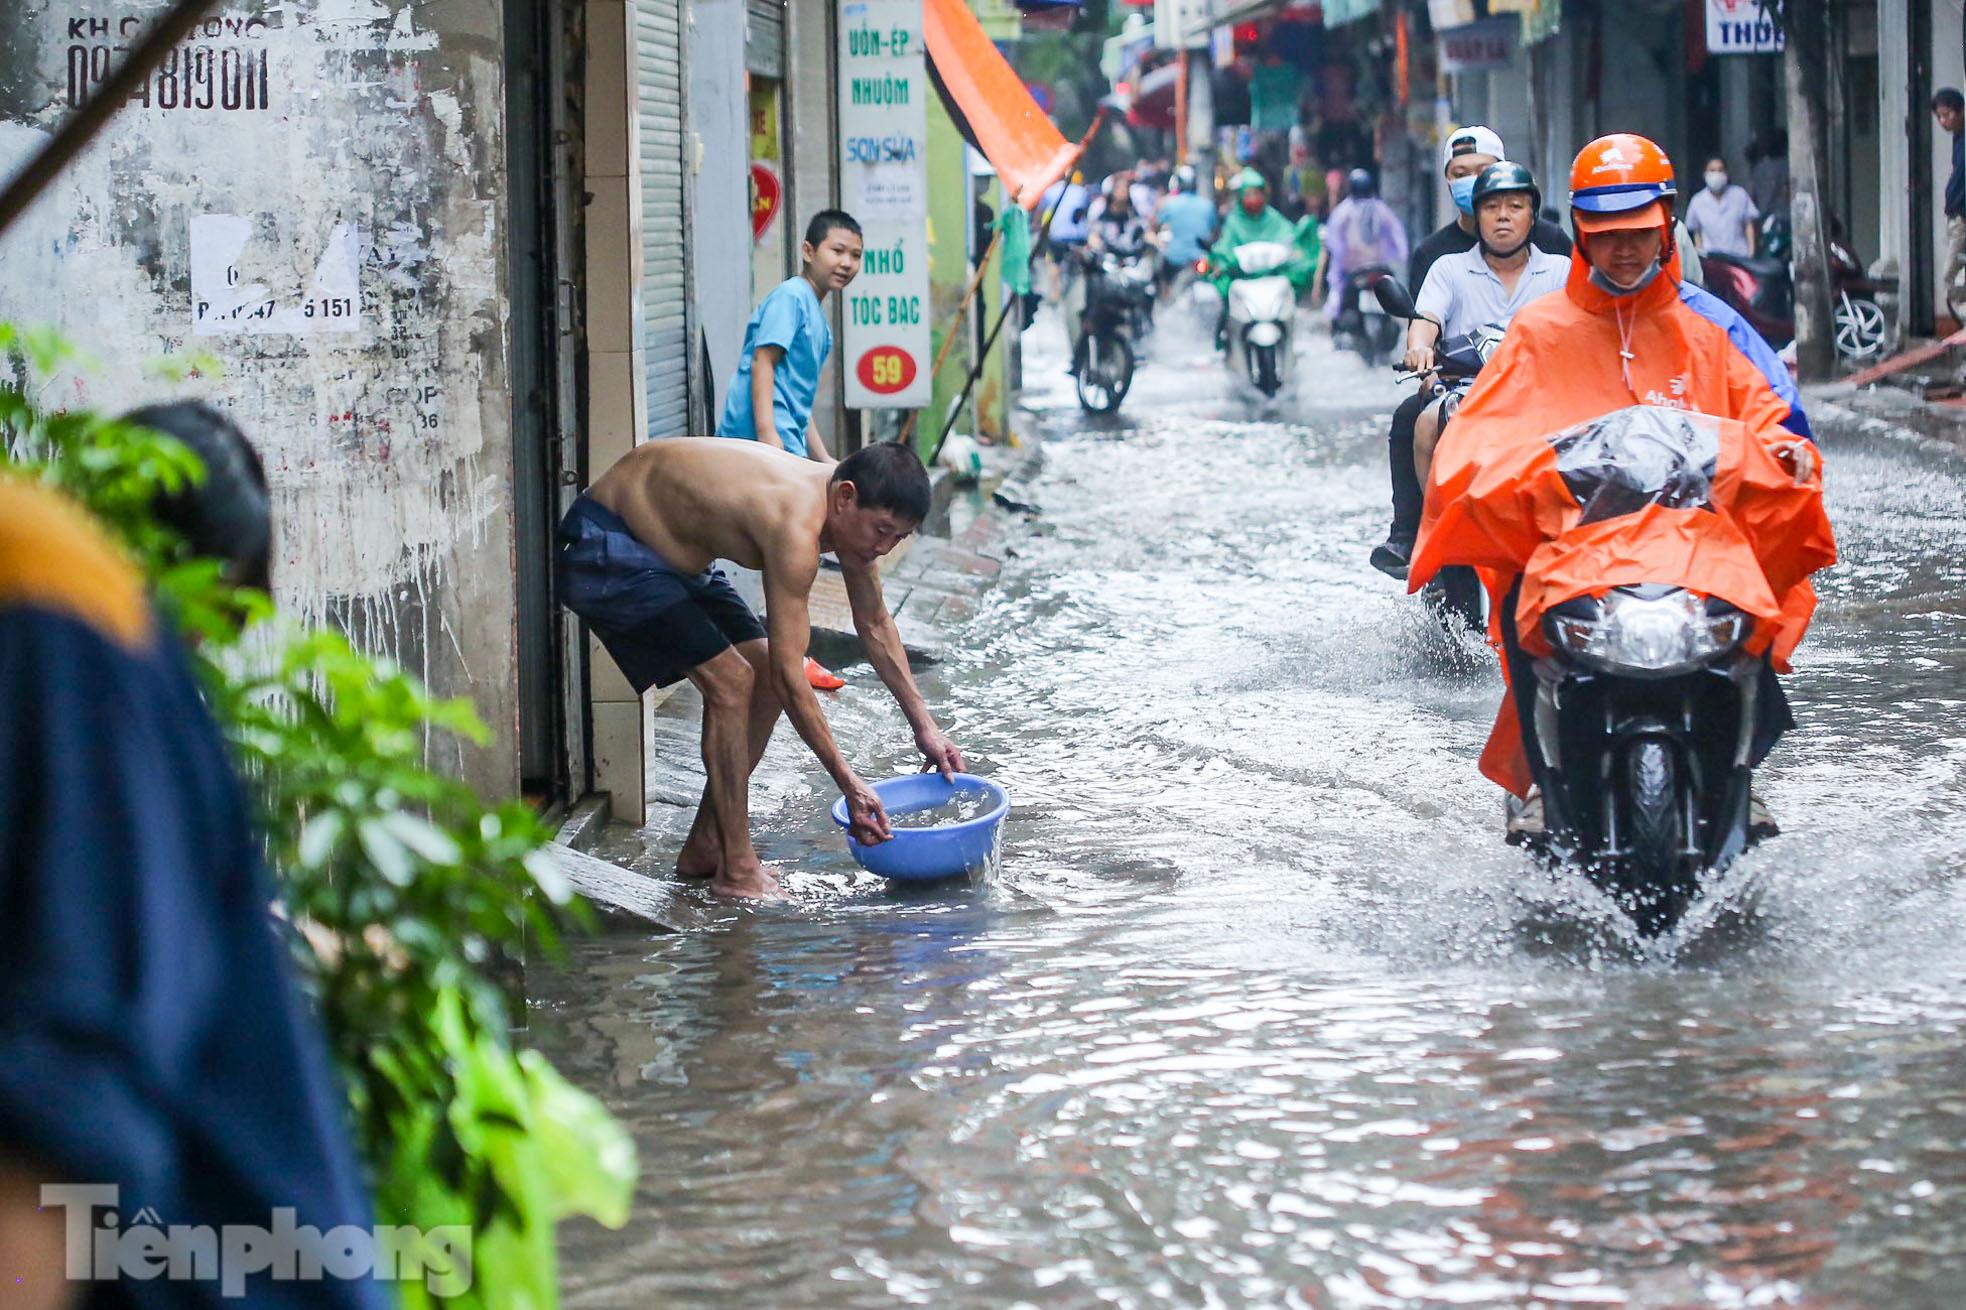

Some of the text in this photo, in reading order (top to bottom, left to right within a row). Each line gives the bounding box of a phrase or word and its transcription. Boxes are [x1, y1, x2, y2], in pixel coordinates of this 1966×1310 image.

[851, 289, 920, 332] TÓC BẠC
[872, 355, 902, 385] 59
